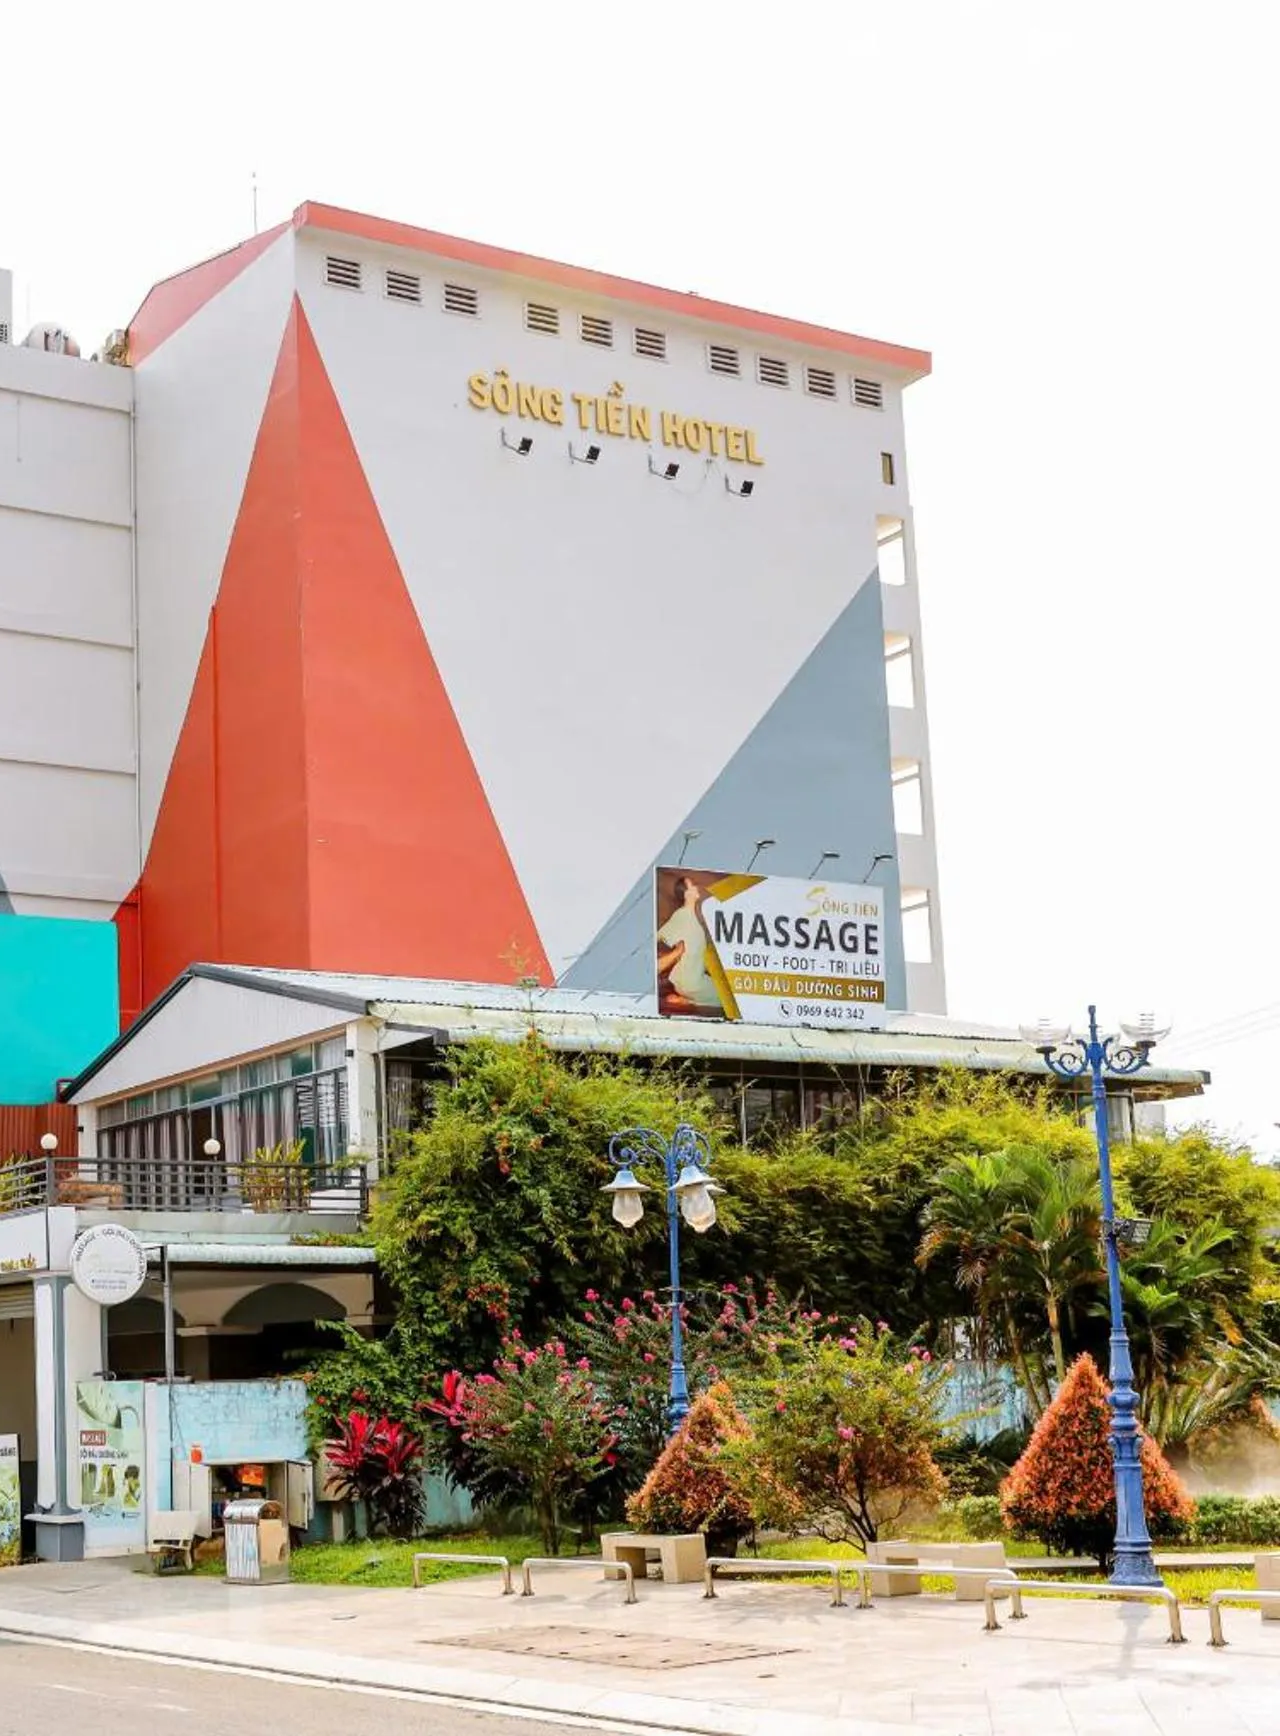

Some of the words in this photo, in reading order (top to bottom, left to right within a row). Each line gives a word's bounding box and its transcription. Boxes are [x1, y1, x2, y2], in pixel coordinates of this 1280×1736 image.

[468, 369, 563, 426] SÔNG
[660, 410, 765, 466] HOTEL
[714, 910, 879, 955] MASSAGE
[734, 952, 769, 968] BODY
[782, 956, 816, 971] FOOT
[847, 984, 879, 999] SINH
[796, 1005, 822, 1017] 0969
[824, 1007, 843, 1018] 642
[846, 1008, 865, 1020] 342
